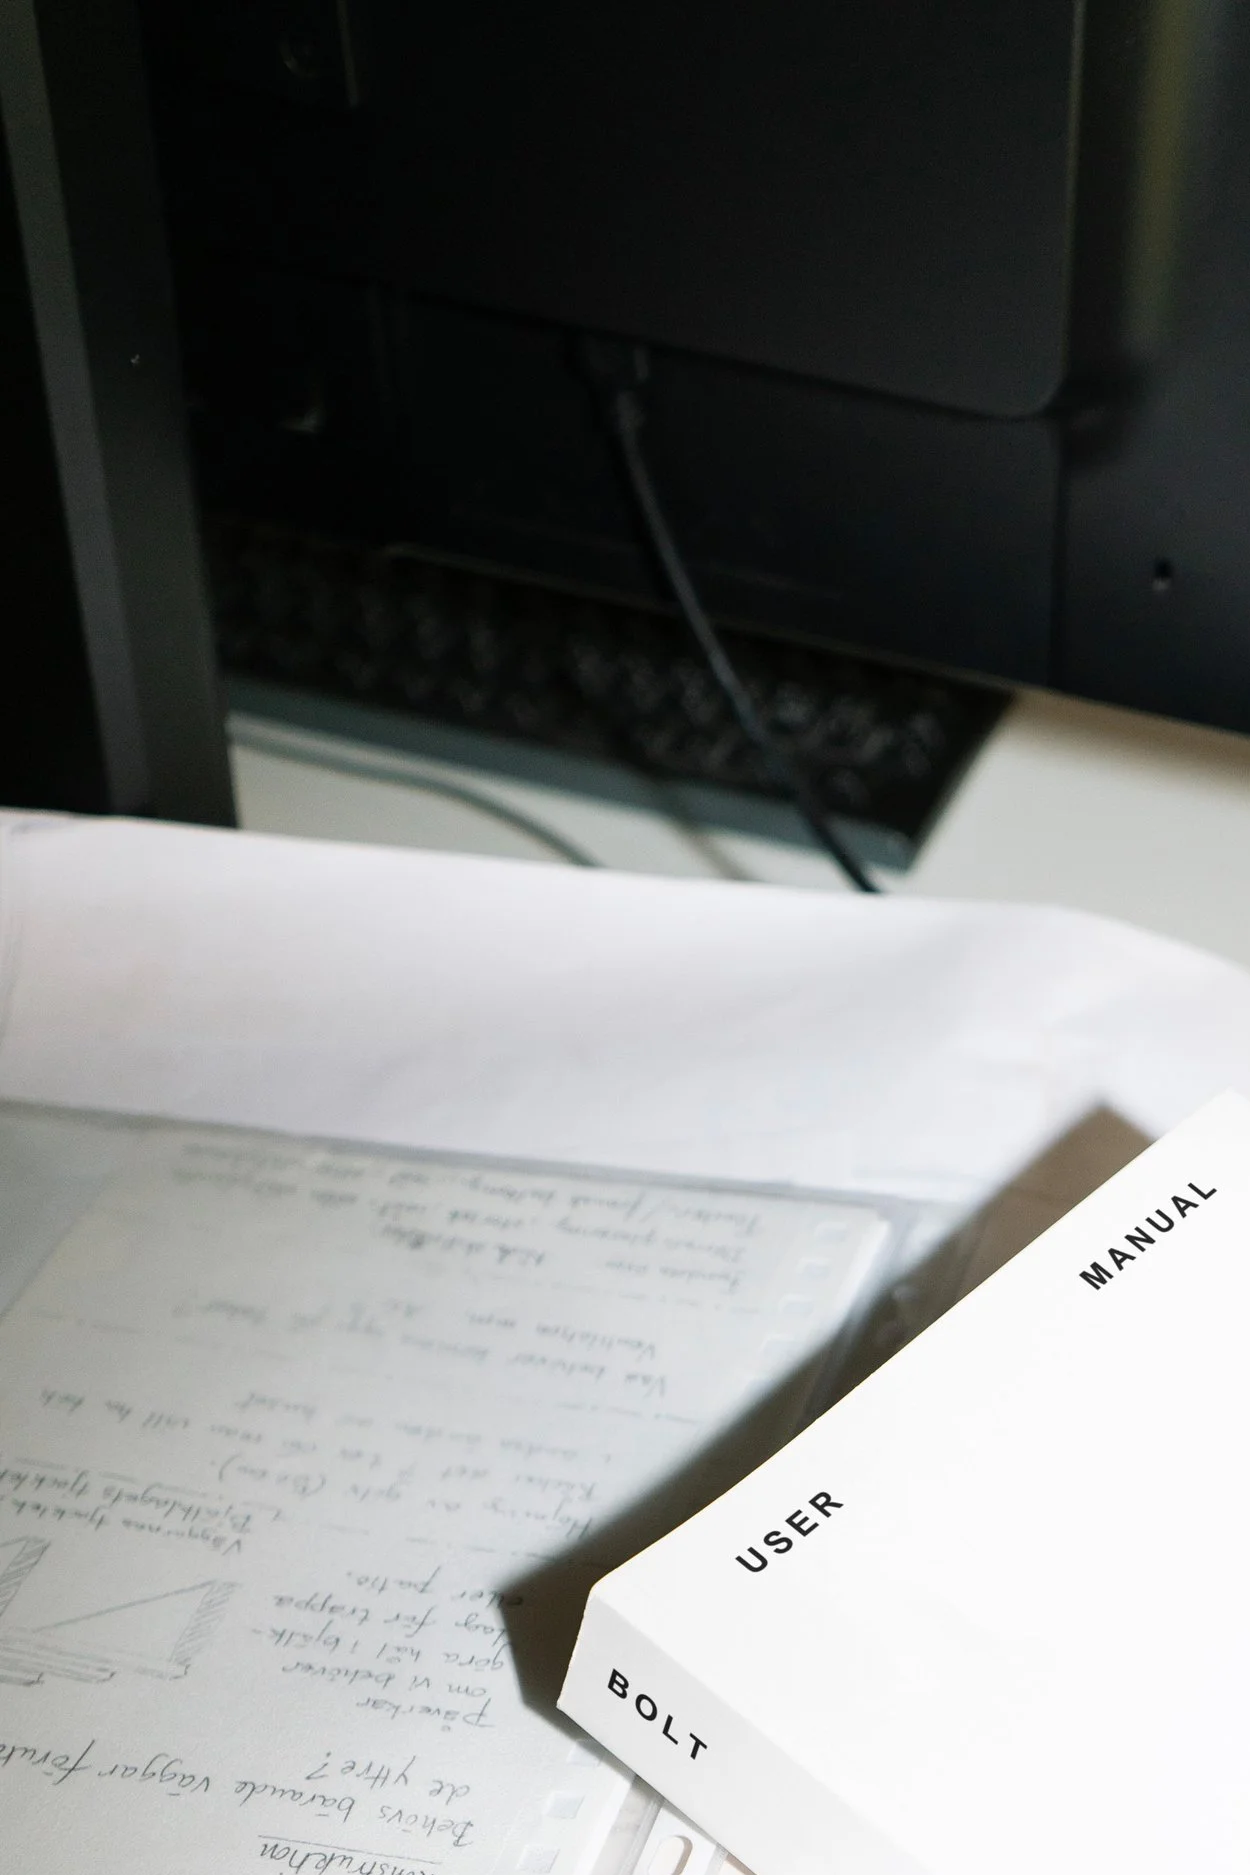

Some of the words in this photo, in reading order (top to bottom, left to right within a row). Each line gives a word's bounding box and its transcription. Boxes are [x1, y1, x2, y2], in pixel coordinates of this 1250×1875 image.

[735, 1492, 843, 1572] USER
[1079, 1183, 1217, 1290] MANUAL
[272, 1592, 371, 1628] trappa
[280, 1660, 396, 1692] behöver
[608, 1668, 707, 1760] BOLT
[97, 1753, 211, 1797] väggar
[428, 1779, 471, 1806] de
[376, 1804, 475, 1849] Behövs
